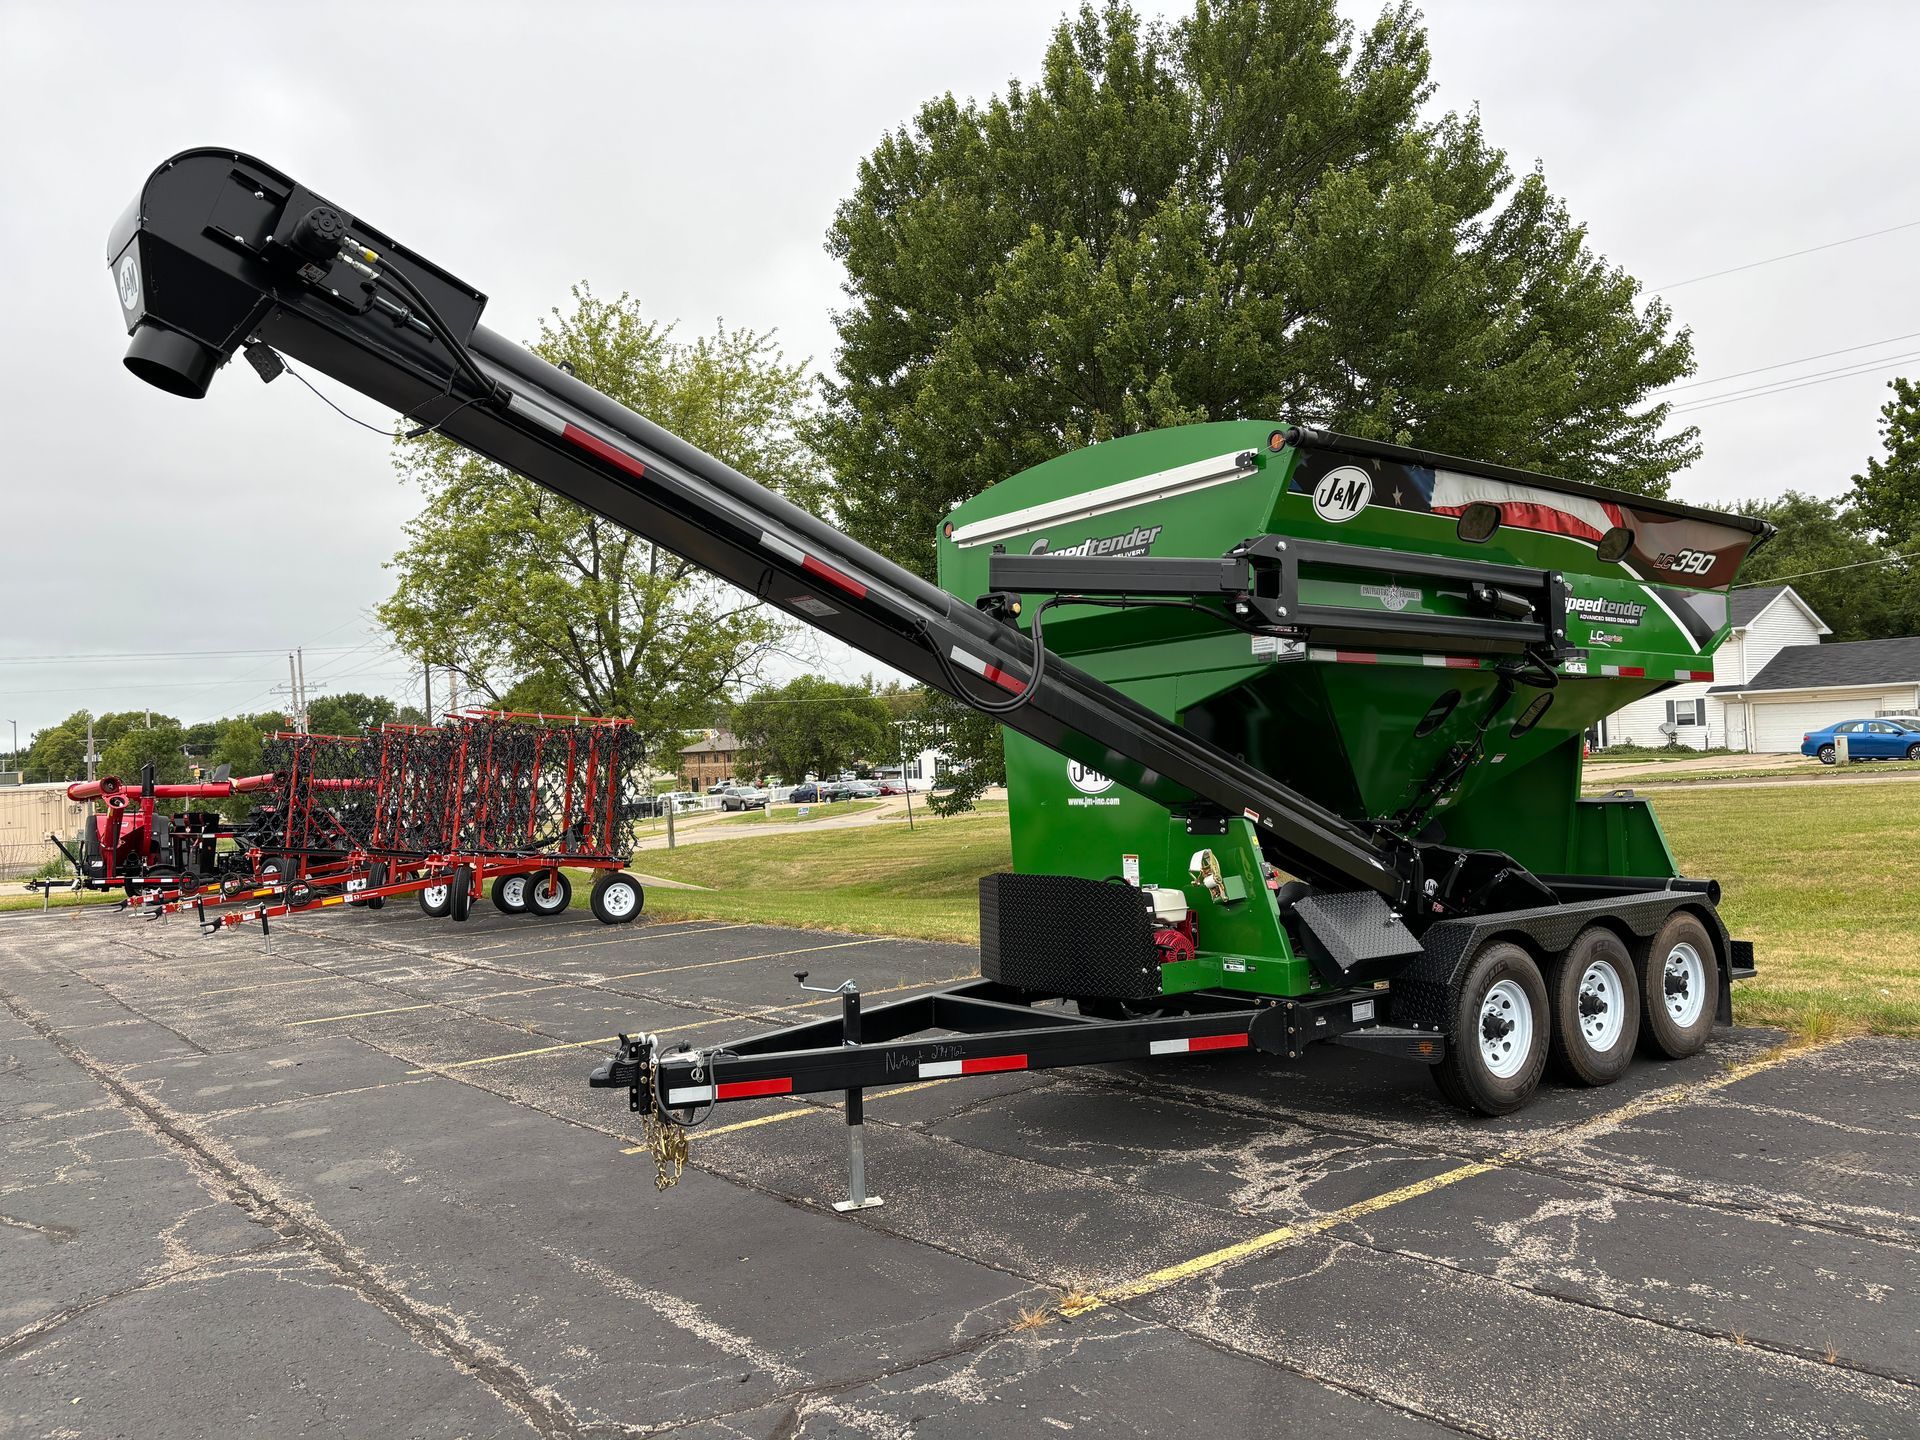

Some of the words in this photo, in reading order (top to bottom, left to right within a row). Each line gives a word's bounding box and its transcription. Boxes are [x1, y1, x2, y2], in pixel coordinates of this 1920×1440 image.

[121, 262, 138, 302] J&M
[1318, 477, 1366, 512] J&M
[1564, 597, 1647, 617] peedtender
[1579, 614, 1605, 622] ADVANCED
[1616, 617, 1639, 625] DELIVERY
[1067, 796, 1120, 808] www.jm-inc.com
